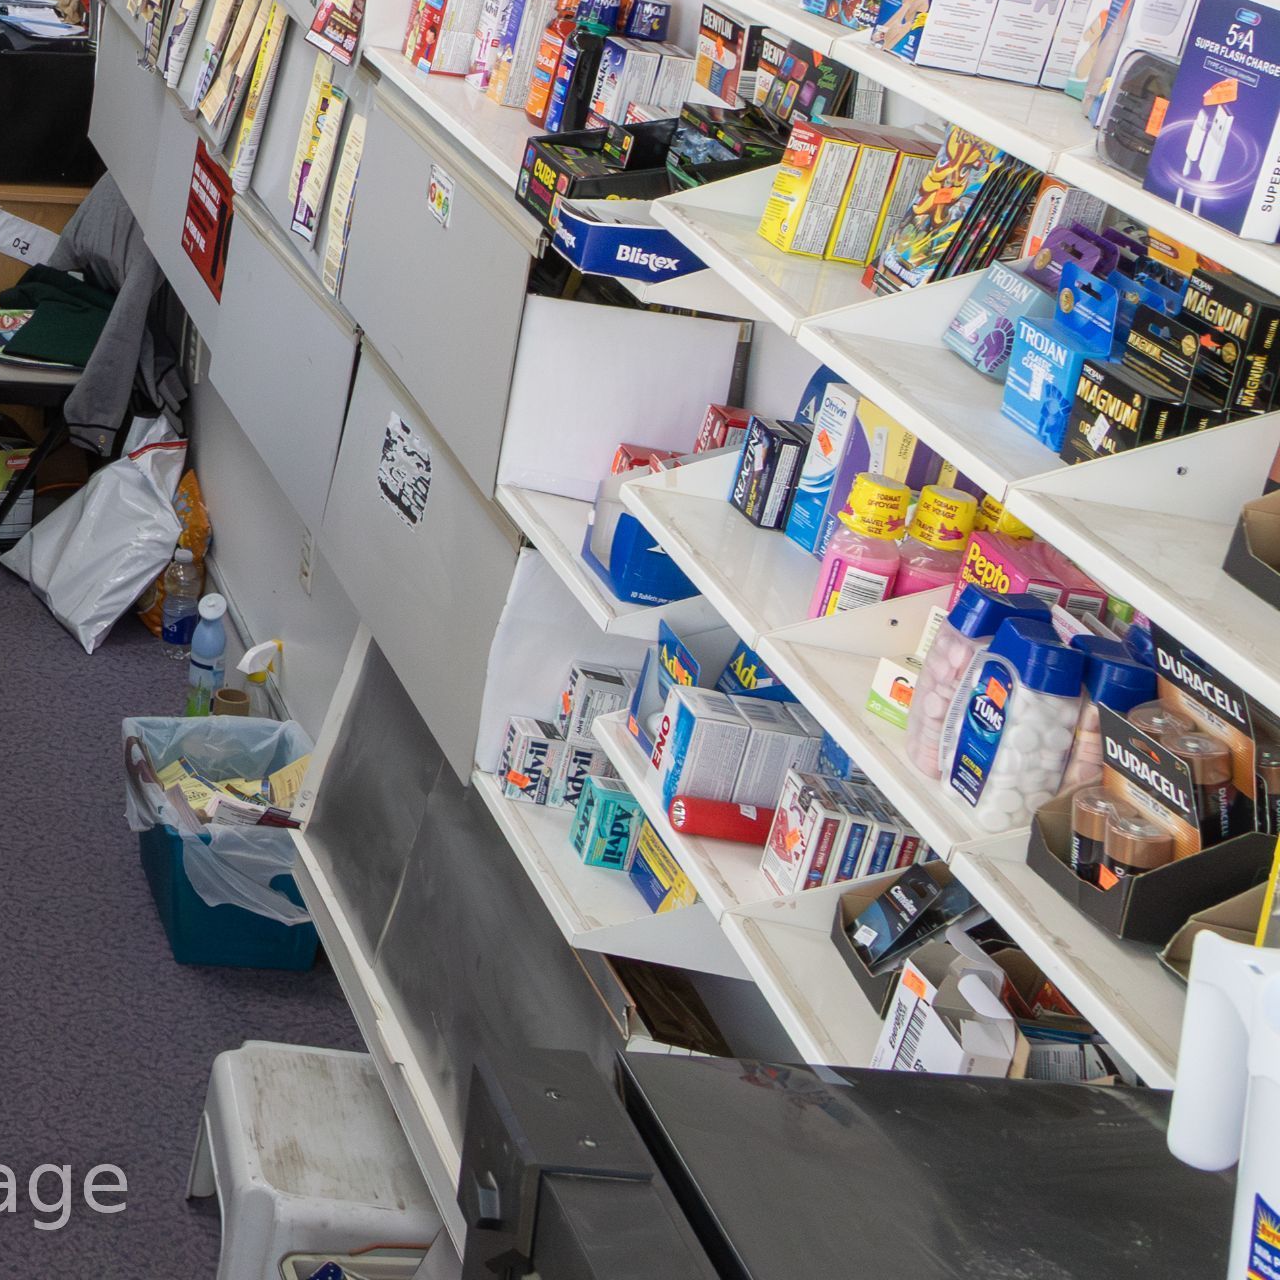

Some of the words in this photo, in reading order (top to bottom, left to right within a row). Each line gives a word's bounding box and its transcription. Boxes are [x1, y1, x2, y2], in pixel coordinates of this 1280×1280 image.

[642, 4, 666, 17] NyQuil
[702, 7, 733, 41] BENYLIN
[1194, 35, 1219, 57] SUPER
[1219, 44, 1245, 66] FLASH
[533, 158, 557, 191] CUBE
[616, 244, 680, 272] Blistex
[987, 261, 1033, 304] TROJAN
[1183, 288, 1250, 341] MAGNUM
[1019, 318, 1068, 367] TROJAN
[1128, 332, 1162, 361] MAGNUM
[1076, 374, 1140, 430] MAGNUM
[1240, 354, 1266, 408] MAGNUM
[824, 396, 848, 419] Otrivin
[733, 426, 765, 506] REACTINE
[934, 498, 959, 512] FORMAT
[966, 542, 1011, 593] Pepto
[1157, 647, 1246, 725] DURACELL
[974, 694, 1005, 730] TUMS
[651, 714, 672, 770] ENO
[523, 740, 549, 800] Advil
[562, 749, 594, 808] Advil
[1104, 736, 1190, 813] DURACELL
[601, 803, 633, 863] Advil
